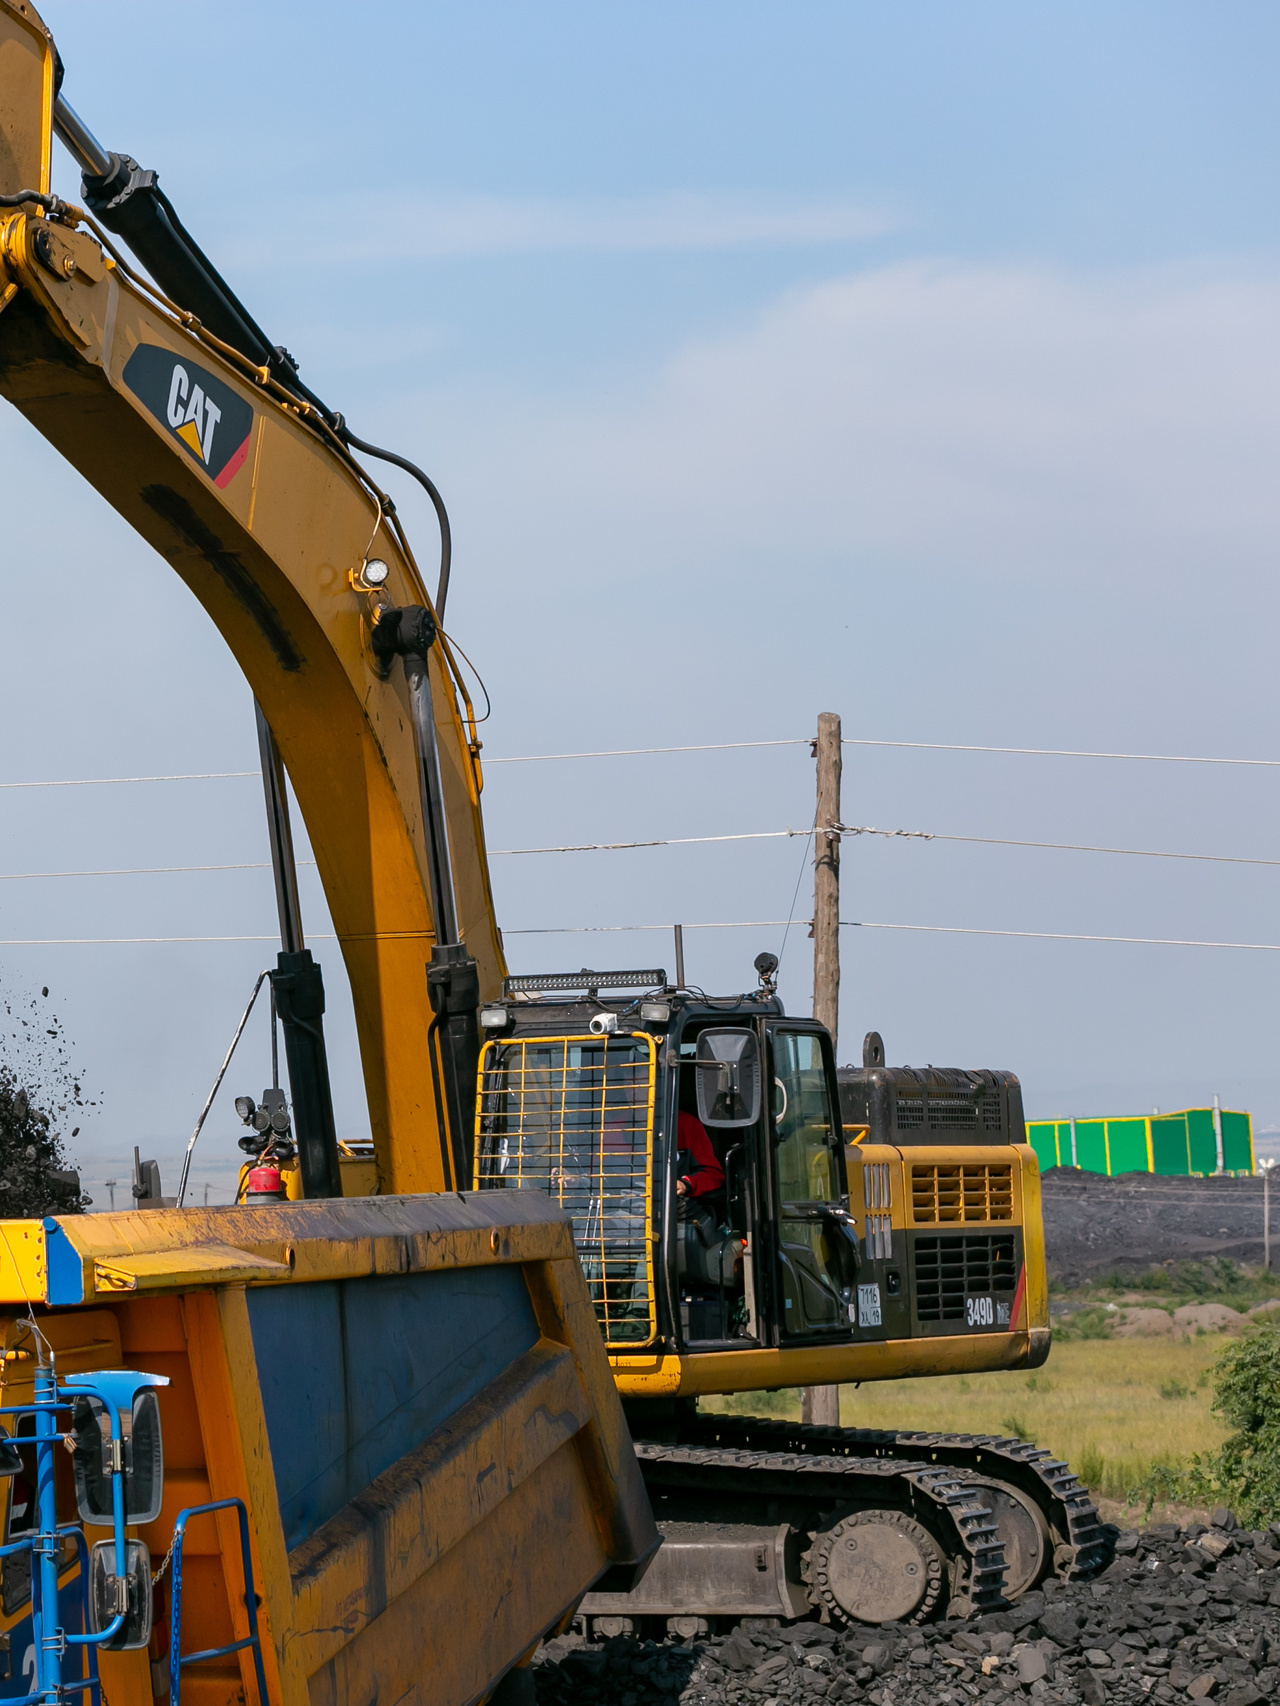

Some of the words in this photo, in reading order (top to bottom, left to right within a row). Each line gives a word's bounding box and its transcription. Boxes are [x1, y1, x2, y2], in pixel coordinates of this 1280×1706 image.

[167, 364, 221, 465] CAT
[860, 1287, 878, 1304] 7116
[967, 1297, 993, 1326] 349D
